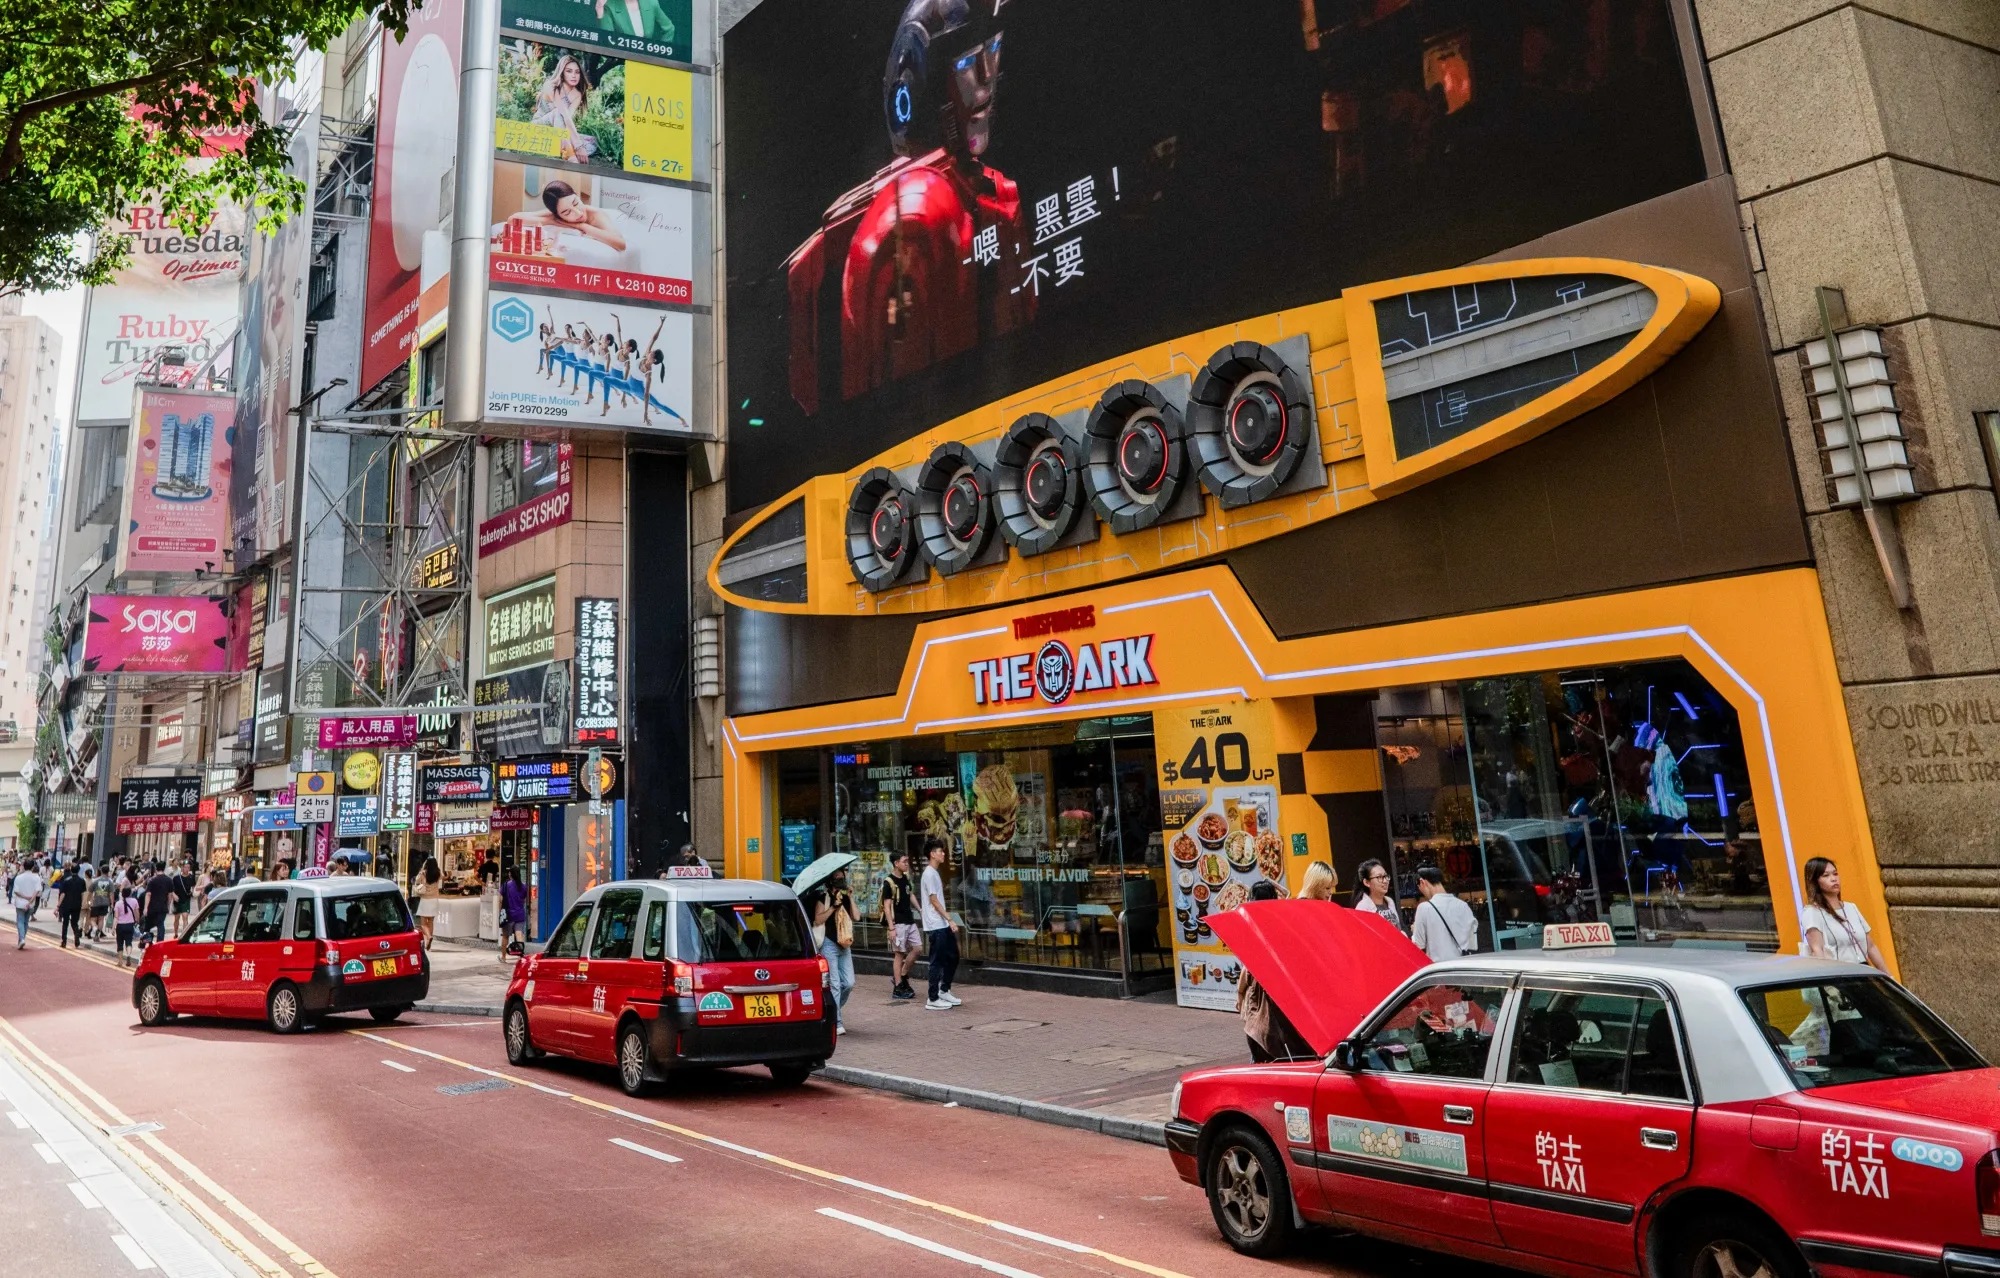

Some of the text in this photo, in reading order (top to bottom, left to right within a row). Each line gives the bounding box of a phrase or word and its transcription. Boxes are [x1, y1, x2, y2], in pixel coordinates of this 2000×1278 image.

[617, 37, 673, 56] 2152 6999
[632, 93, 685, 120] OASIS
[632, 115, 685, 131] spa medical
[632, 154, 647, 168] 6F
[661, 159, 684, 173] 27F
[600, 189, 640, 201] Switzerland
[119, 229, 244, 255] Tuesda
[162, 259, 240, 281] Optimus
[495, 261, 546, 276] GLYCEL
[574, 272, 688, 298] 11/F 2810 8206
[370, 309, 404, 348] SOMETHING
[403, 304, 411, 320] IS
[501, 314, 525, 326] PURE
[116, 313, 209, 344] Ruby
[489, 391, 580, 407] Join PURE in Motion
[488, 402, 510, 412] 25/F
[519, 405, 543, 415] 2970
[544, 407, 568, 417] 2299
[560, 443, 572, 455] Toys
[480, 491, 570, 547] taketoys.hk SEX SHOP
[489, 592, 555, 647] 名錶維修中心
[1012, 604, 1096, 640] TRANSFORMERS
[141, 635, 172, 651] 莎莎
[489, 649, 508, 666] WATCH
[508, 642, 532, 662] SERVICE
[579, 601, 592, 716] Watch Repair Center
[591, 600, 616, 716] 名錶維修中心
[968, 633, 1160, 704] THE ARK
[341, 719, 395, 734] 成人用品
[585, 717, 618, 728] 28933688
[1190, 715, 1233, 728] THE ARK
[364, 735, 389, 743] SHOP
[1903, 730, 1984, 758] PLAZA
[1162, 731, 1275, 786] $40 UP
[426, 767, 479, 778] MASSAGE
[517, 763, 551, 775] CHANGE
[1878, 764, 1903, 786] 38
[517, 782, 548, 798] CHANGE
[878, 776, 955, 791] DINING EXPERIENCE
[122, 787, 199, 811] 名錶維修
[300, 797, 329, 806] 24 hrs
[454, 801, 478, 809] MINT
[1163, 793, 1200, 804] LUNCH
[303, 809, 325, 820] 全日
[340, 815, 377, 823] FACTORY
[492, 808, 529, 819] 成人用品
[1164, 814, 1187, 825] SET
[436, 821, 488, 836] 名錶維修中心
[304, 868, 326, 877] TAXI
[674, 866, 711, 877] TAXI
[976, 867, 1089, 882] INFUSED WITH FLAVOR
[1558, 925, 1611, 943] TAXI
[242, 960, 256, 970] 的士
[375, 966, 395, 976] 6252
[241, 970, 254, 981] TAXI
[593, 985, 607, 999] 的士
[592, 998, 606, 1013] TAXI
[713, 997, 719, 1005] 4
[754, 995, 769, 1006] YC
[750, 1006, 777, 1017] 7881
[1535, 1130, 1582, 1164] 的士
[1821, 1128, 1885, 1165] 的士
[1536, 1158, 1587, 1194] TAXI
[1822, 1159, 1890, 1200] TAXI
